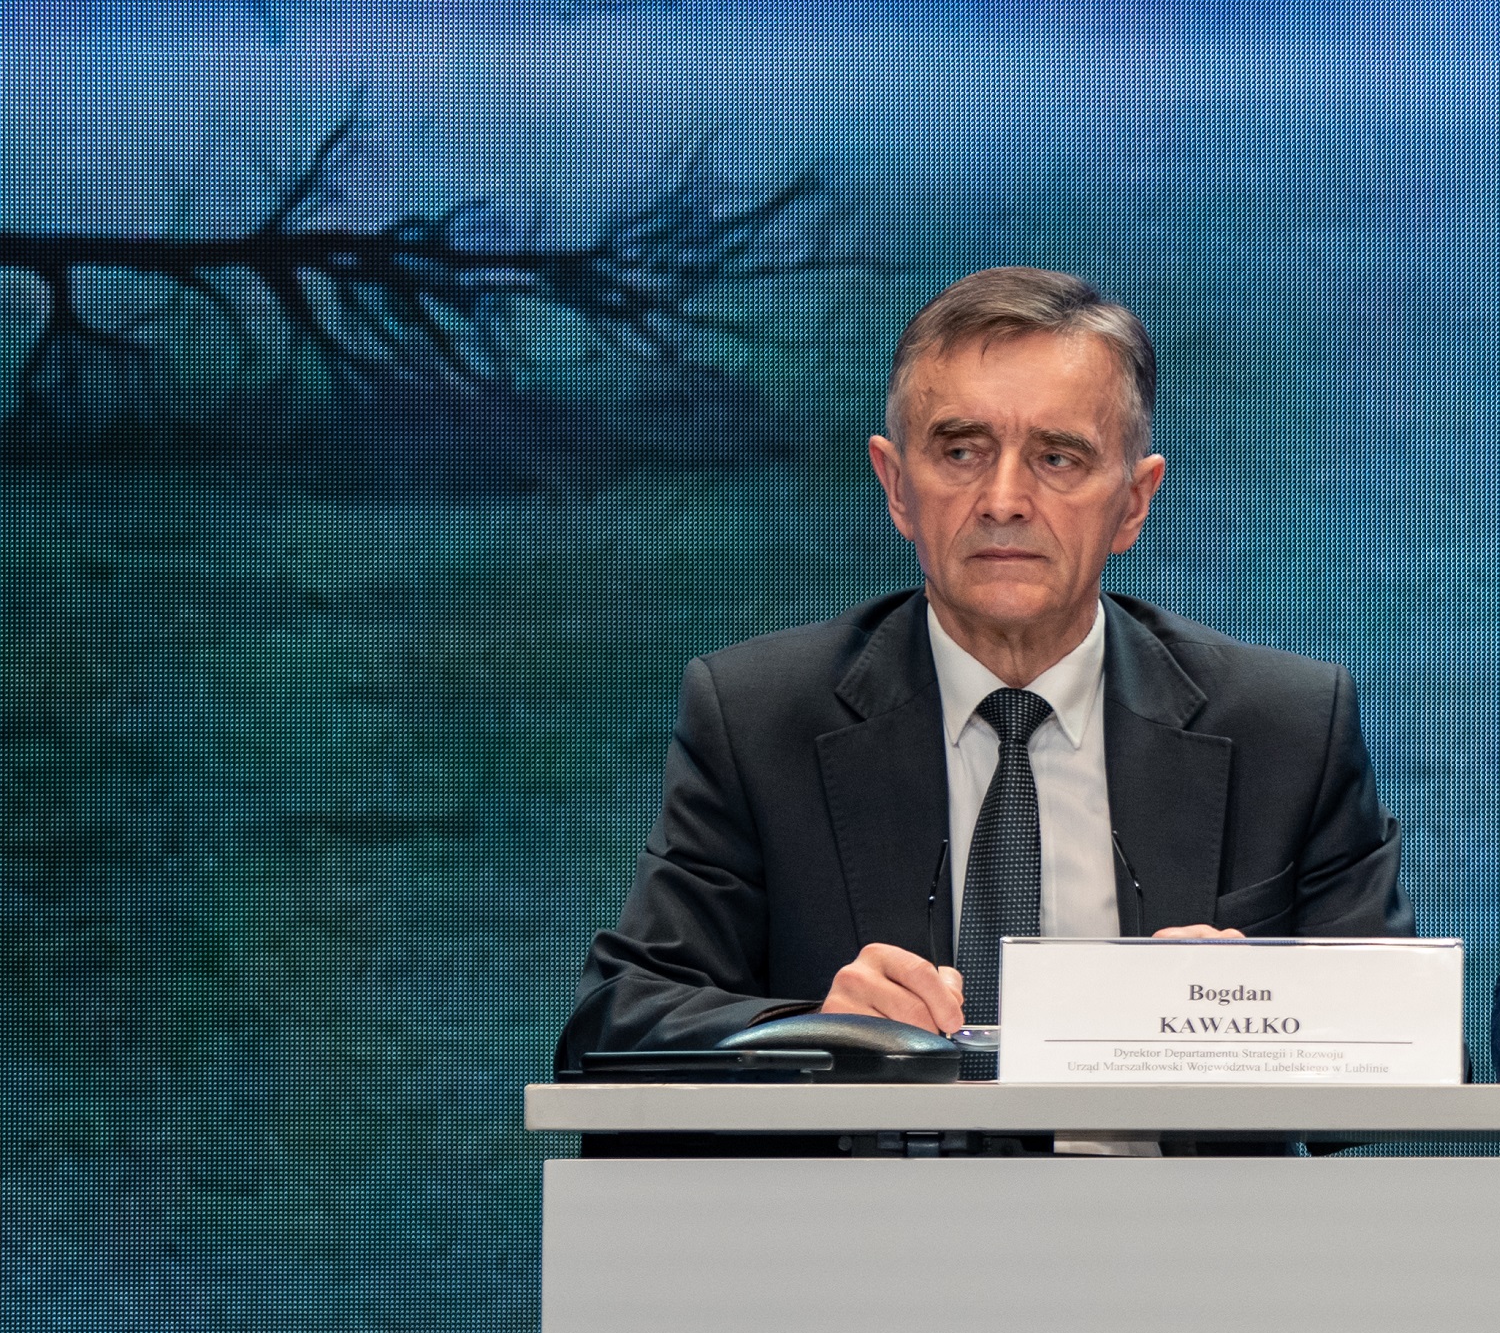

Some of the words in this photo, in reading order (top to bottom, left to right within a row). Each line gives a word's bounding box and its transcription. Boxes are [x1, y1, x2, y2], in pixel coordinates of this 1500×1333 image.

[1188, 984, 1272, 1007] Bogdan
[1159, 1016, 1302, 1035] KAWAŁKO
[1113, 1048, 1161, 1060] Dyrektor
[1164, 1048, 1239, 1060] Departamentu
[1241, 1048, 1286, 1061] Strategii
[1296, 1049, 1344, 1061] Rozwoju
[1067, 1061, 1100, 1072] Urząd
[1103, 1061, 1183, 1072] Marszałkowski
[1187, 1061, 1261, 1074] Województwa
[1264, 1062, 1329, 1075] Lubelskiego
[1331, 1065, 1341, 1073] w
[1344, 1062, 1389, 1074] Lublinie
